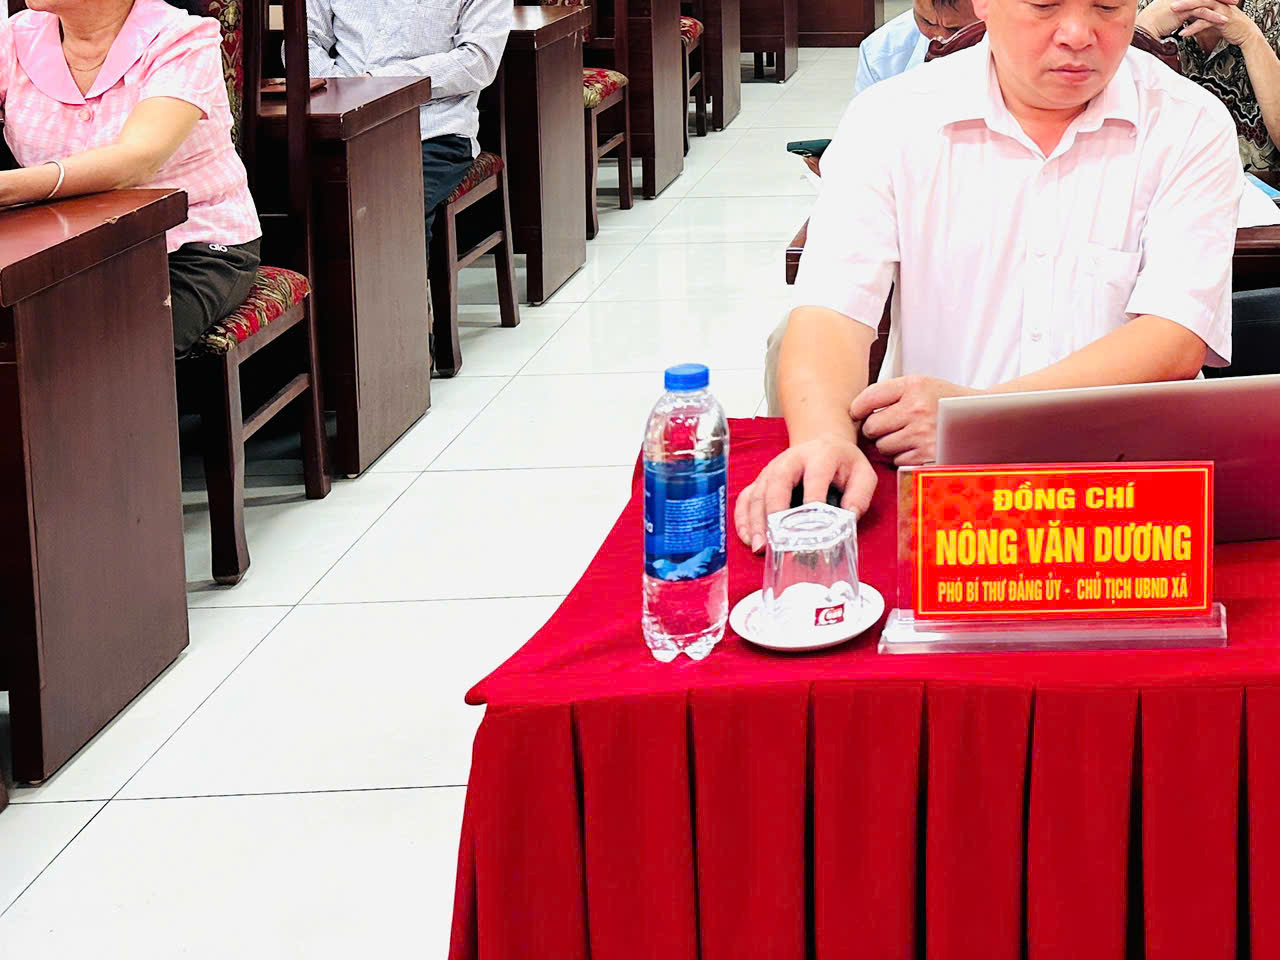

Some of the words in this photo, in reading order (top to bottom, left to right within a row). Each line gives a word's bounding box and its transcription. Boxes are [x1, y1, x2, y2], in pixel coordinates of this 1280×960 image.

[993, 481, 1076, 511] ĐỒNG
[1085, 481, 1136, 509] CHÍ
[935, 521, 1018, 566] NÔNG
[1026, 519, 1085, 564] VĂN
[1094, 521, 1191, 563] DƯƠNG
[937, 576, 963, 602] PHÓ
[966, 576, 980, 602] BÍ
[981, 577, 1007, 602] THƯ
[1008, 572, 1043, 601] ĐẢNG
[1045, 571, 1062, 601] ỦY
[1077, 570, 1102, 600] CHỦ
[1104, 577, 1132, 604] TỊCH
[1135, 577, 1169, 599] UBND
[1171, 572, 1188, 599] XÃ
